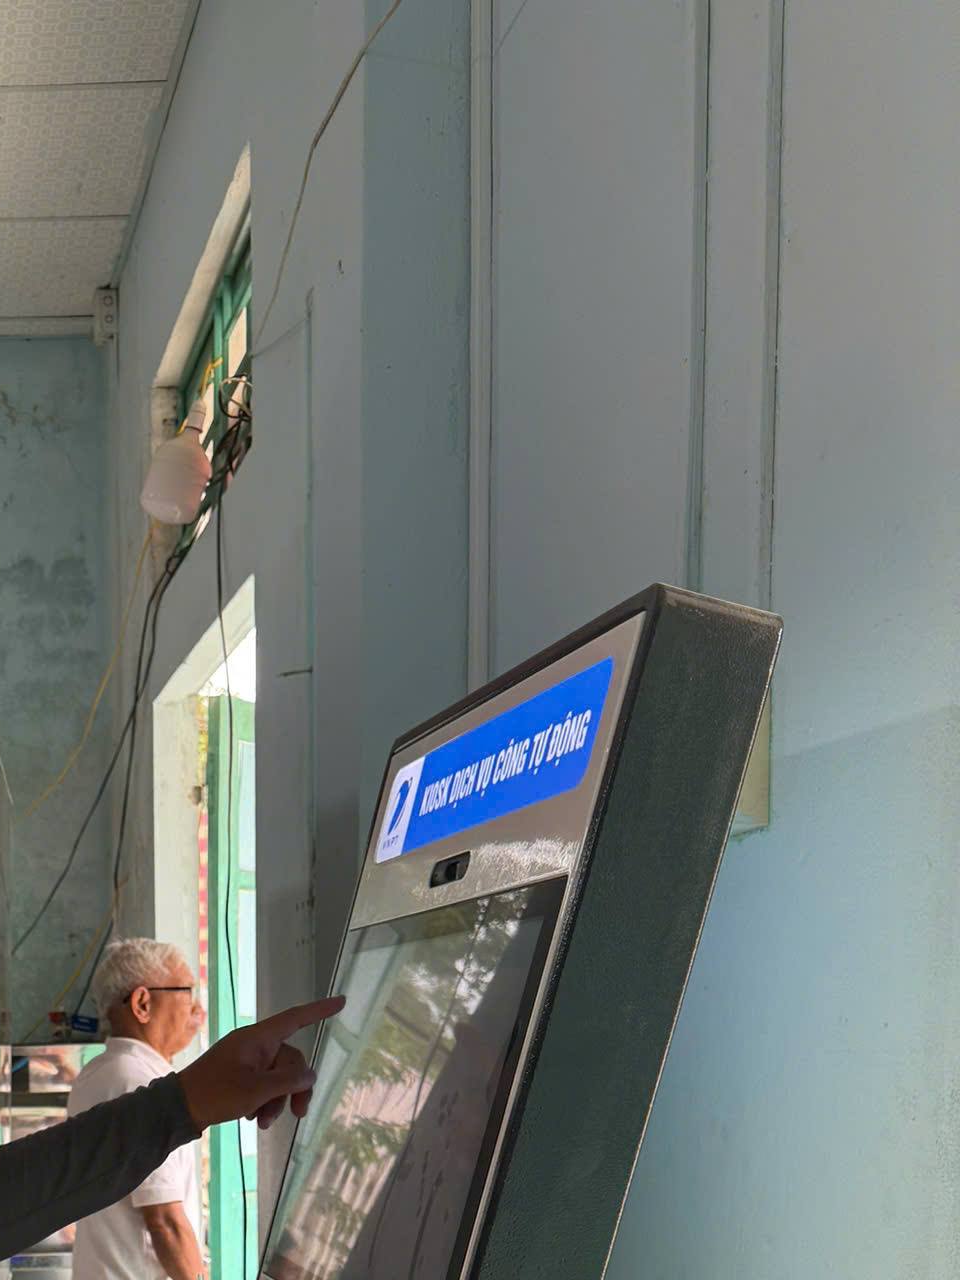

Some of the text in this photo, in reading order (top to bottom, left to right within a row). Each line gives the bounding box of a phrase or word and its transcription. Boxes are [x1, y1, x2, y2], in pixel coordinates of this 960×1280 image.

[419, 709, 592, 817] KIOSK DỊCH VỤ CÔNG TỰ ĐỘNG
